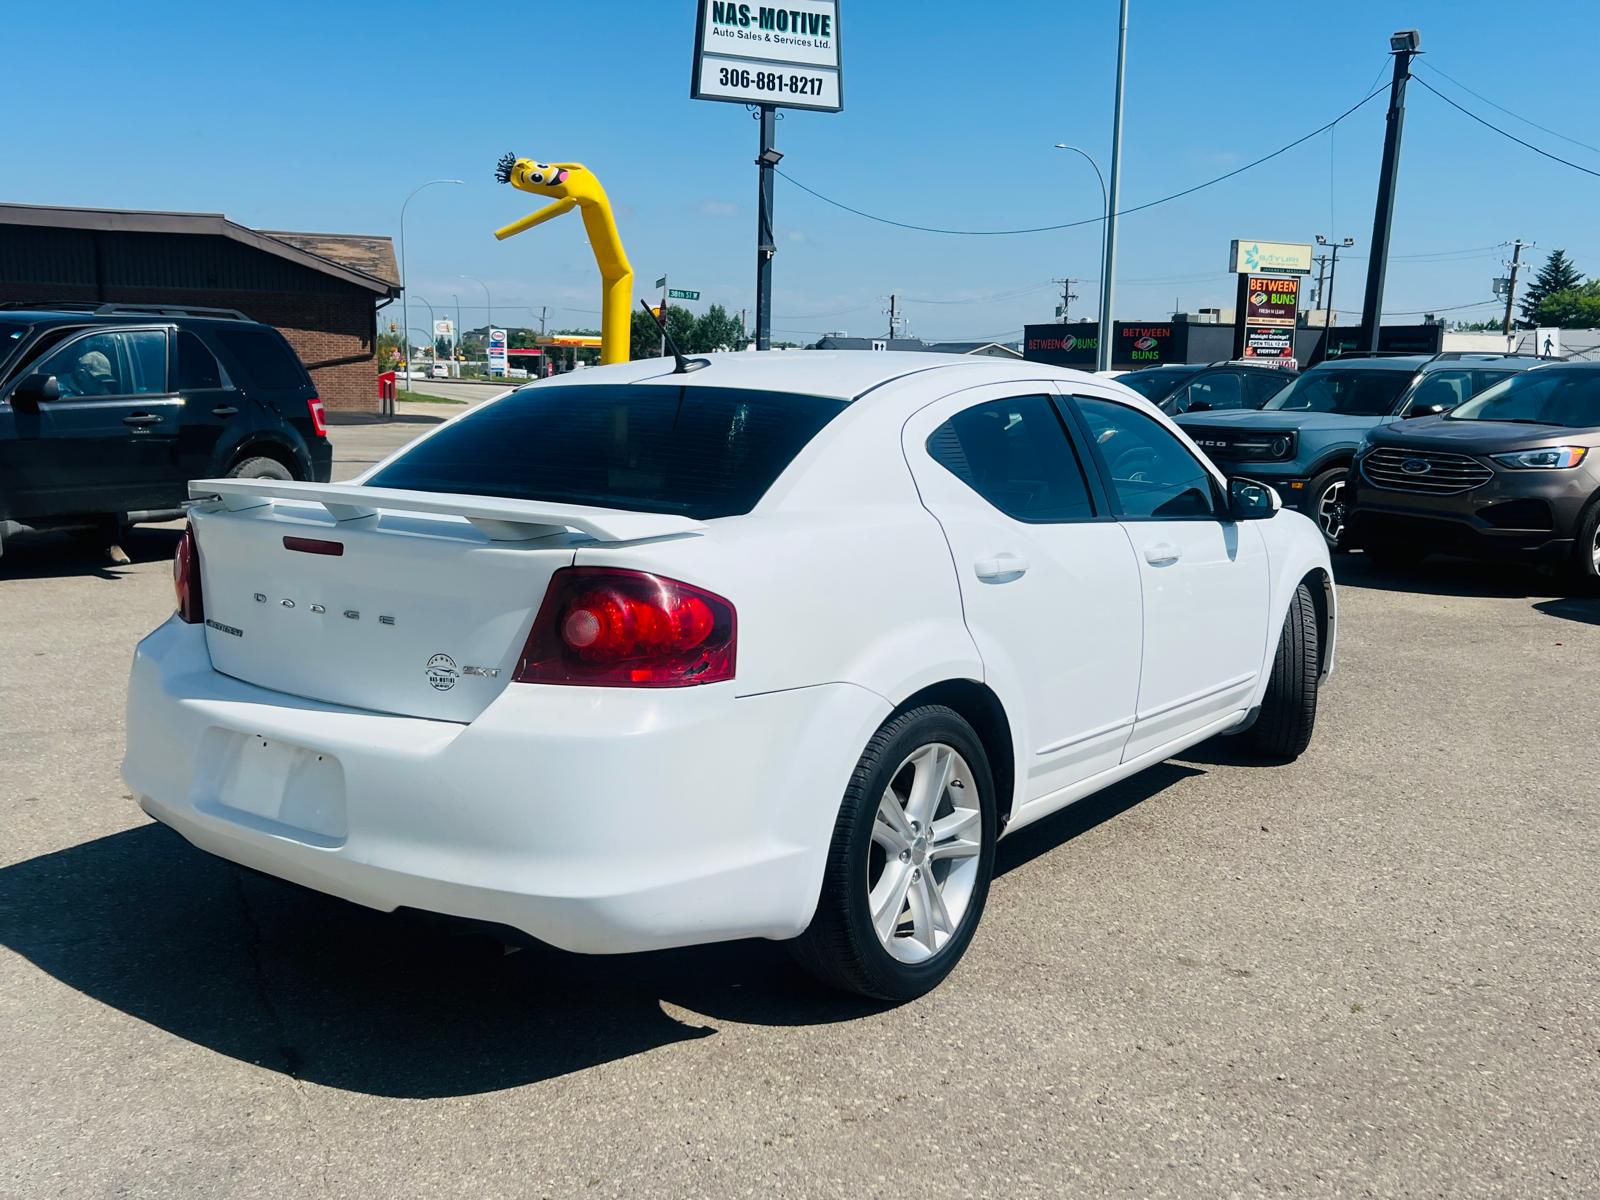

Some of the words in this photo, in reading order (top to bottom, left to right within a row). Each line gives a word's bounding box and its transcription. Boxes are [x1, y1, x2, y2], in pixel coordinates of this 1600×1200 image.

[712, 1, 831, 37] NAS-MOTIVE
[713, 27, 734, 38] Auto
[737, 30, 762, 41] Sales
[764, 33, 771, 43] &
[773, 35, 812, 47] Services
[814, 39, 831, 49] Ltd.
[719, 67, 823, 96] 306-881-8217
[1250, 278, 1297, 293] BETWEEN
[670, 290, 685, 298] 38th
[1271, 293, 1295, 305] BUNS
[1122, 328, 1171, 337] BETWEEN
[1028, 339, 1061, 350] BETWEEN
[1077, 338, 1098, 349] BUNS
[1131, 351, 1159, 360] BUNS
[254, 593, 395, 625] DODGE
